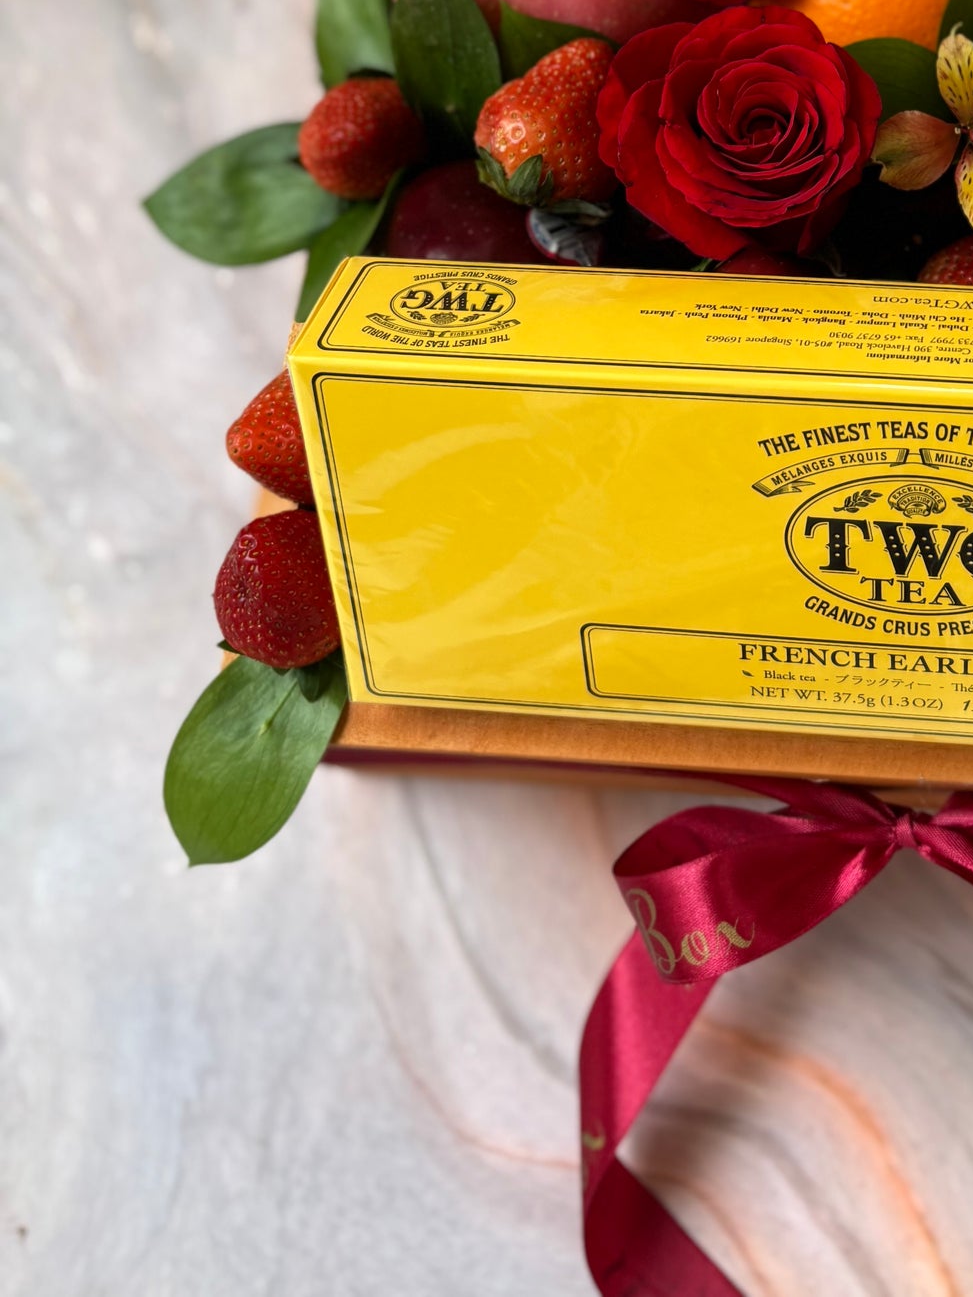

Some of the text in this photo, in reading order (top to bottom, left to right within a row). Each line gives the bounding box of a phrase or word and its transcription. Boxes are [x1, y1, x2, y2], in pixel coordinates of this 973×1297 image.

[413, 271, 517, 285] GRANDS CRUS PRESTIGE
[440, 281, 488, 292] TEA
[401, 289, 504, 313] TWG
[695, 302, 717, 311] York
[720, 304, 742, 312] New
[751, 306, 779, 314] Delhi
[640, 308, 677, 318] Jakarta
[685, 311, 710, 320] Penh
[712, 312, 748, 321] Phnom
[813, 308, 852, 317] Toronto
[862, 311, 889, 319] Doha
[899, 313, 926, 321] Minh
[758, 315, 792, 323] Manila
[802, 316, 846, 326] Bangkok
[928, 314, 947, 322] Chi
[856, 318, 896, 328] Lumpur
[900, 322, 928, 330] Kuala
[938, 323, 969, 332] Dubai
[362, 326, 391, 340] WORLD
[829, 331, 853, 339] 9030
[856, 332, 881, 340] 6737
[391, 334, 409, 345] THE
[452, 337, 487, 347] FINEST
[490, 334, 510, 343] THE
[706, 335, 742, 344] 169662
[746, 336, 792, 346] Singapore
[884, 334, 901, 342] +65
[930, 336, 954, 345] 7997
[866, 342, 908, 352] Havelock
[914, 344, 932, 353] 390
[934, 356, 960, 365] More
[758, 433, 800, 457] THE
[802, 424, 872, 447] FINEST
[877, 421, 929, 439] TEAS
[935, 423, 960, 442] OF
[771, 457, 835, 486] MÉLANGES
[840, 451, 888, 465] EXQUIS
[860, 576, 966, 606] TEA
[805, 595, 877, 631] GRANDS
[883, 620, 931, 636] CRUS
[738, 643, 877, 669] FRENCH
[764, 670, 796, 680] Black
[836, 674, 932, 690] ブラックティー
[952, 682, 973, 693] Thé
[750, 686, 789, 698] NET
[794, 689, 828, 701] WT.
[833, 692, 876, 707] 37.5g
